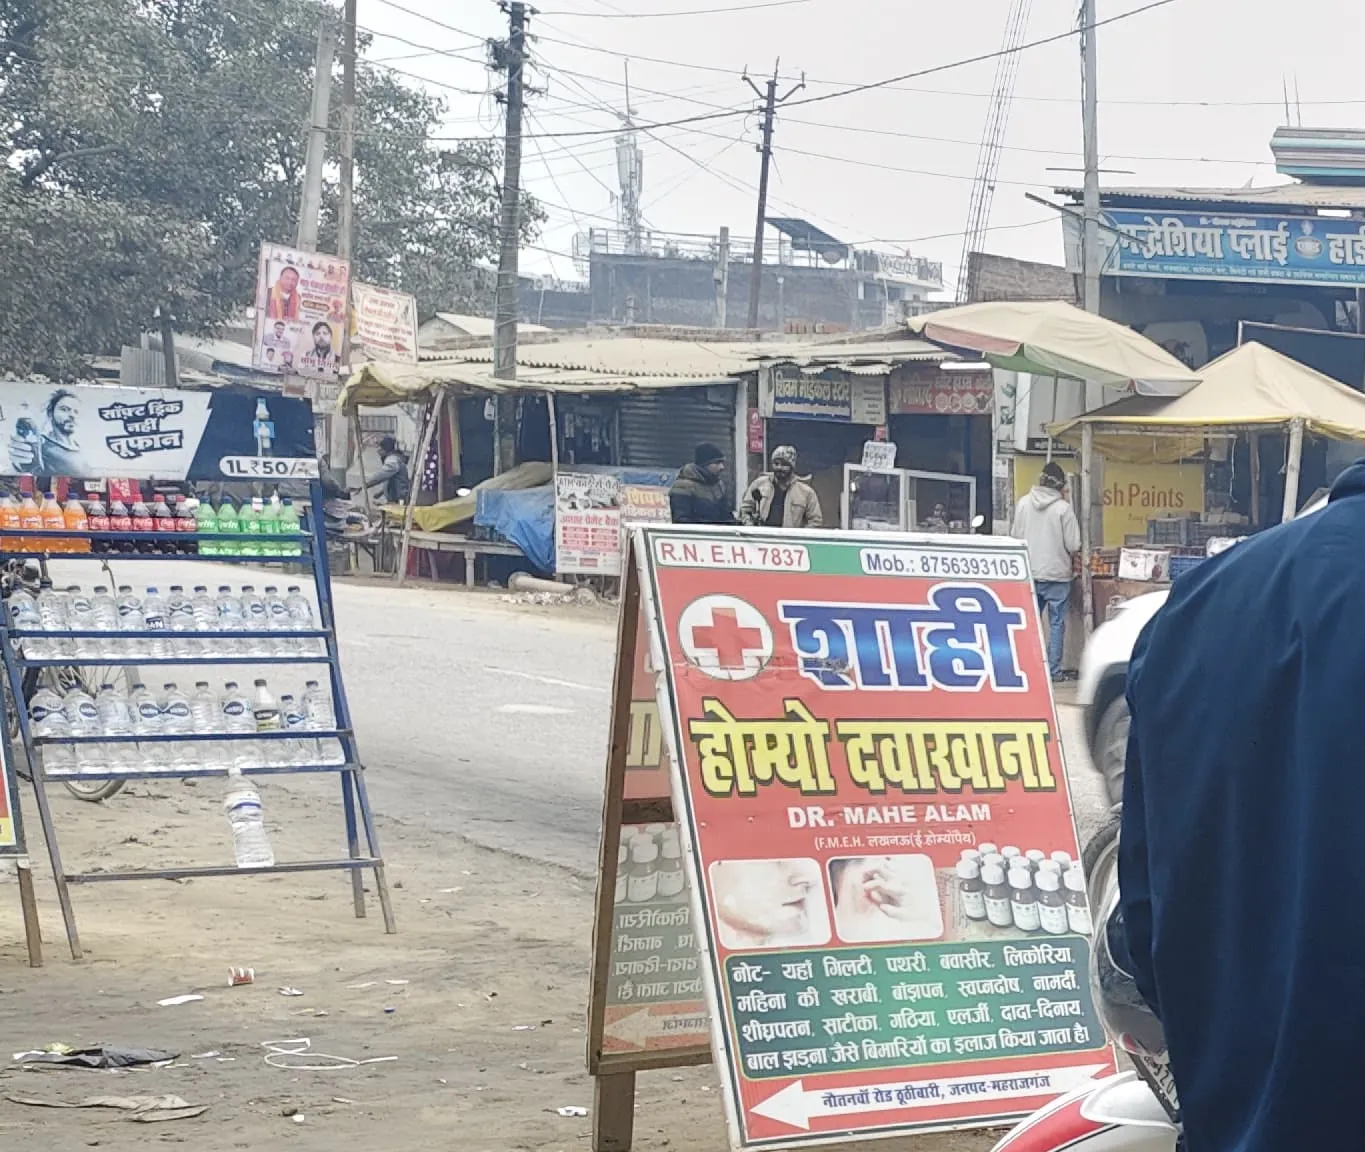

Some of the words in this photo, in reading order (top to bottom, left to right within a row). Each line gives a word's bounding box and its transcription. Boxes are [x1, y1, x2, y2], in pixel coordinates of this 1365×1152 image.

[1227, 222, 1289, 266] प्लाई
[1128, 482, 1184, 508] Paints
[660, 543, 704, 563] R.N.
[712, 547, 752, 566] E.H.
[758, 548, 804, 567] 7837
[867, 553, 915, 573] Mob.:
[921, 556, 1020, 577] 8756393105
[782, 583, 1024, 690] शाही
[689, 697, 836, 796] होम्यो
[836, 717, 1057, 794] दवाखाना
[787, 806, 834, 828] DR.
[843, 805, 917, 825] MAHE
[925, 803, 991, 823] ALAM
[736, 991, 786, 1013] महिना
[797, 987, 820, 1008] की
[746, 1051, 780, 1071] बाल
[831, 1041, 859, 1064] जैसे
[930, 1036, 951, 1054] का
[953, 1031, 997, 1053] इलाज
[999, 1025, 1037, 1048] किया
[1039, 1027, 1073, 1045] जाता
[873, 1086, 893, 1103] रोड
